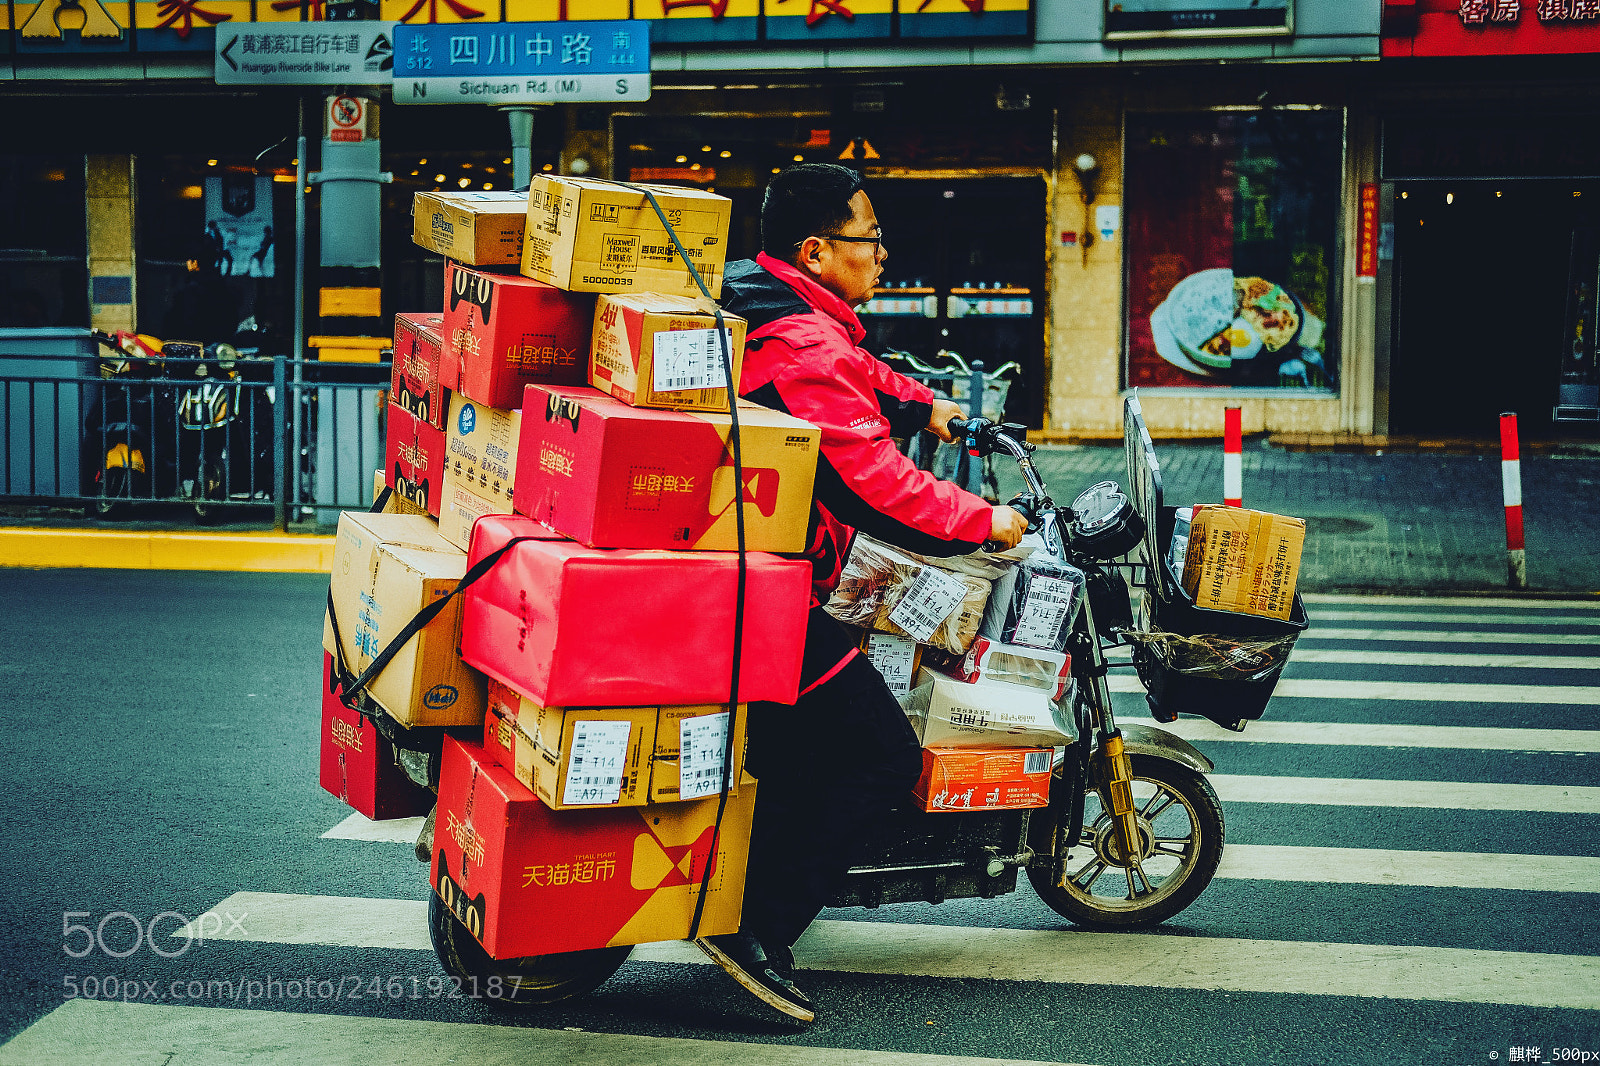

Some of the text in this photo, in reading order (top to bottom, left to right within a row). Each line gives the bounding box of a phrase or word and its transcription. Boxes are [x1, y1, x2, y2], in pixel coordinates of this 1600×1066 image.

[242, 34, 361, 55] 黄浦滨江自行车道
[410, 35, 430, 53] 北
[611, 30, 631, 50] 南
[450, 32, 594, 67] 四川中路
[406, 56, 433, 70] 512
[608, 54, 635, 66] 444
[241, 62, 350, 75] Huangpu Riverside Bike Lane
[413, 82, 427, 98] N
[459, 79, 582, 95] Sichuan Rd. (M)
[616, 79, 629, 95] S
[606, 237, 636, 247] Maxwell
[609, 245, 632, 254] House
[600, 303, 619, 330] Aji
[506, 345, 577, 367] 天猫超市
[540, 449, 574, 478] 天猫超市
[632, 474, 695, 492] 天猫超市
[923, 594, 942, 616] T14
[902, 613, 922, 634] A91
[879, 664, 901, 676] T14
[332, 716, 363, 753] 天猫超市
[701, 747, 723, 761] T14
[593, 757, 615, 768] T14
[581, 788, 604, 799] A91
[695, 779, 717, 793] A91
[445, 809, 485, 867] 天猫超市
[574, 851, 616, 861] TMALL MART
[522, 860, 616, 888] 天猫超市
